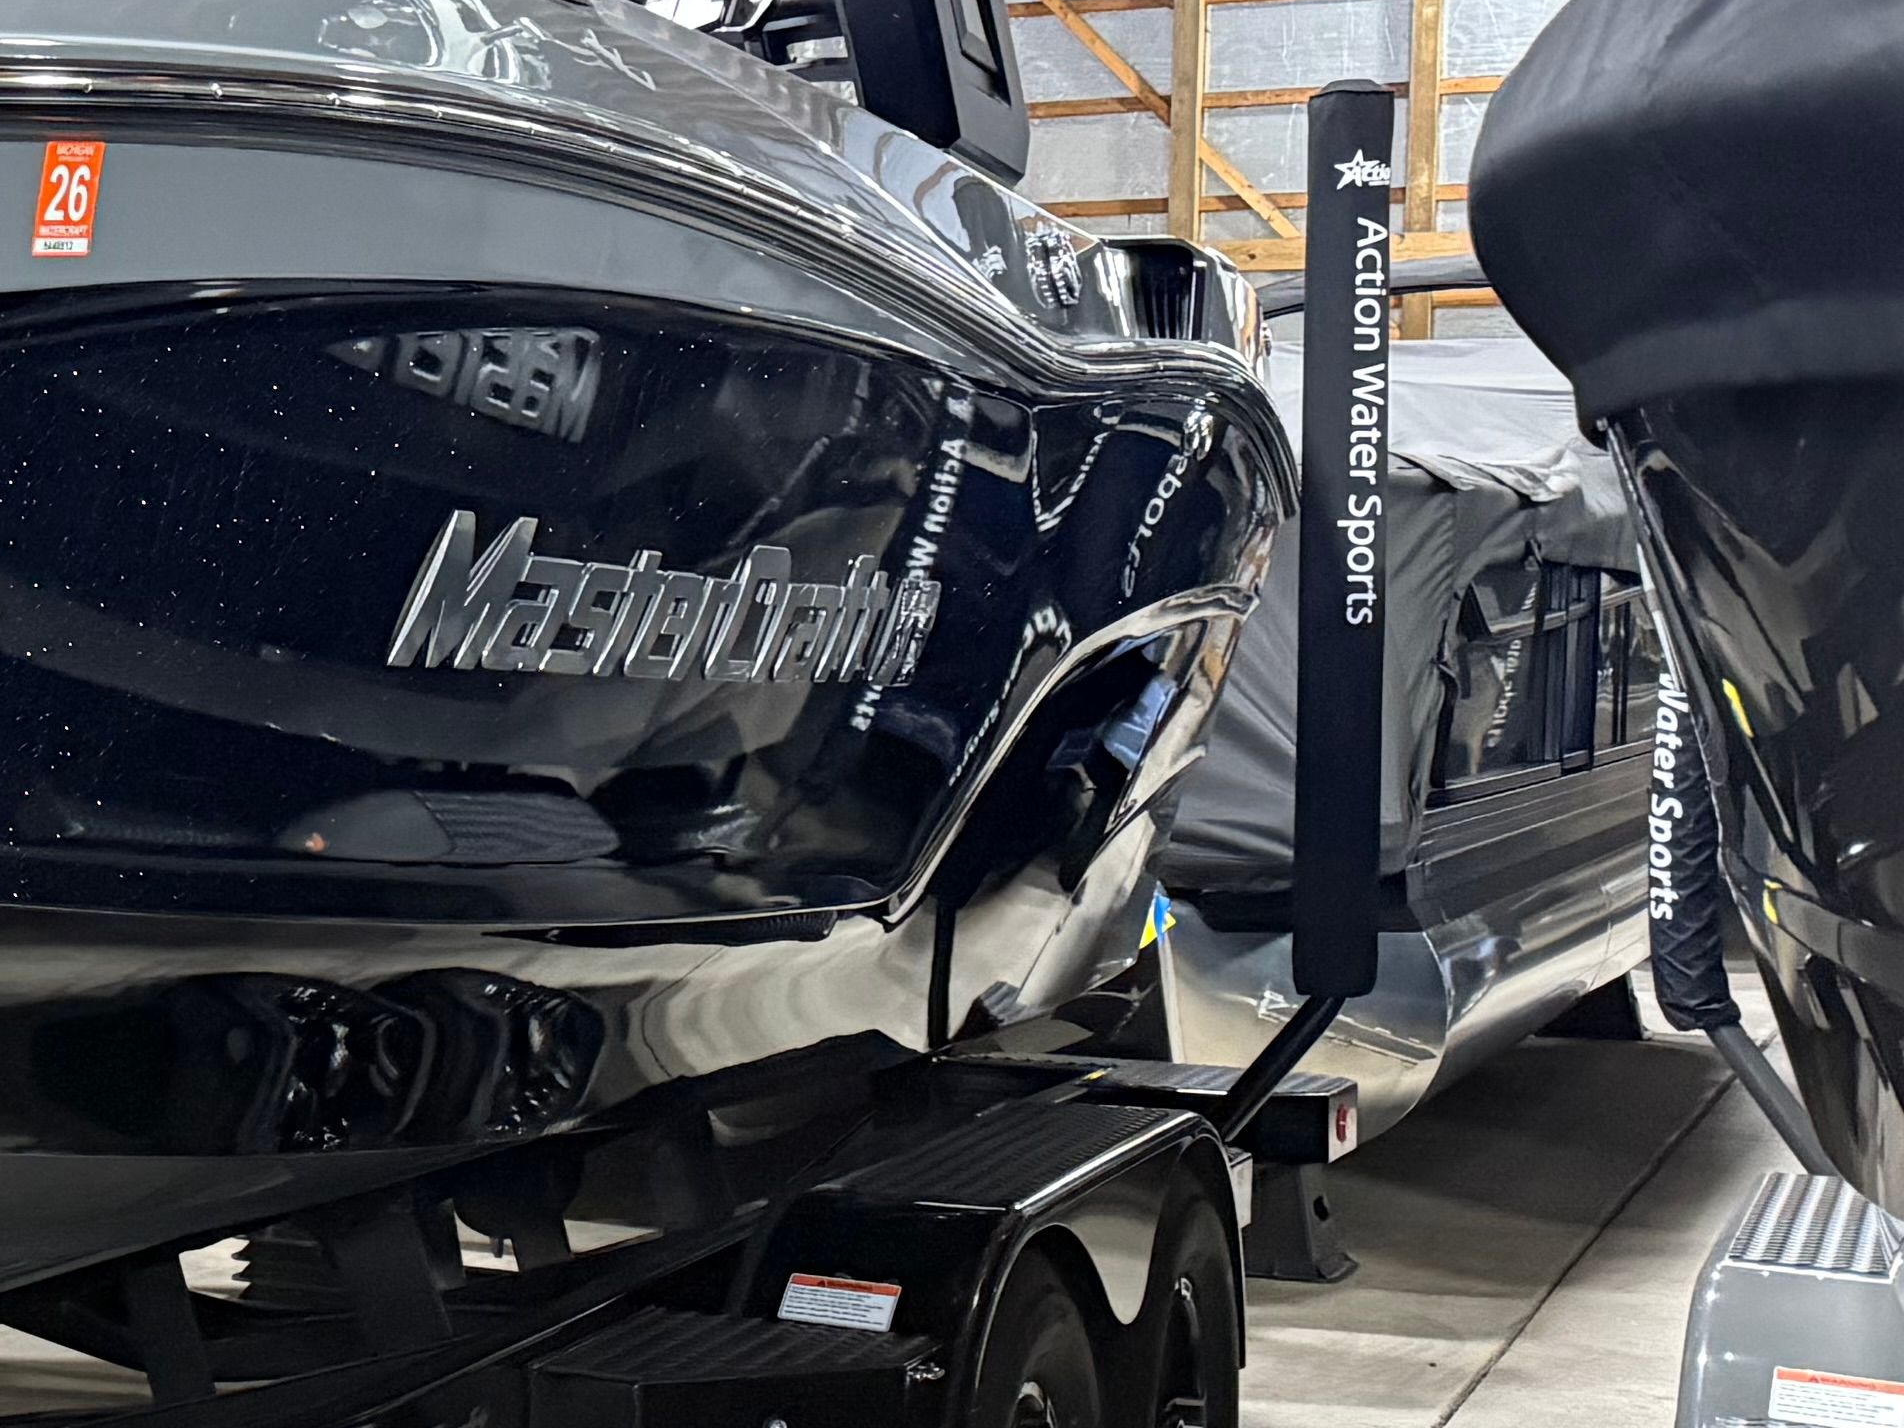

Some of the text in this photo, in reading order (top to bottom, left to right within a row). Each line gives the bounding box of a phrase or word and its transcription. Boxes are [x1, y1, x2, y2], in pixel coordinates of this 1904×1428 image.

[43, 164, 91, 222] 26
[1352, 215, 1389, 352] Action
[1349, 362, 1387, 486] Water
[386, 508, 941, 687] MasterCraft
[1337, 493, 1383, 626] Sports
[1648, 793, 1684, 922] Sports
